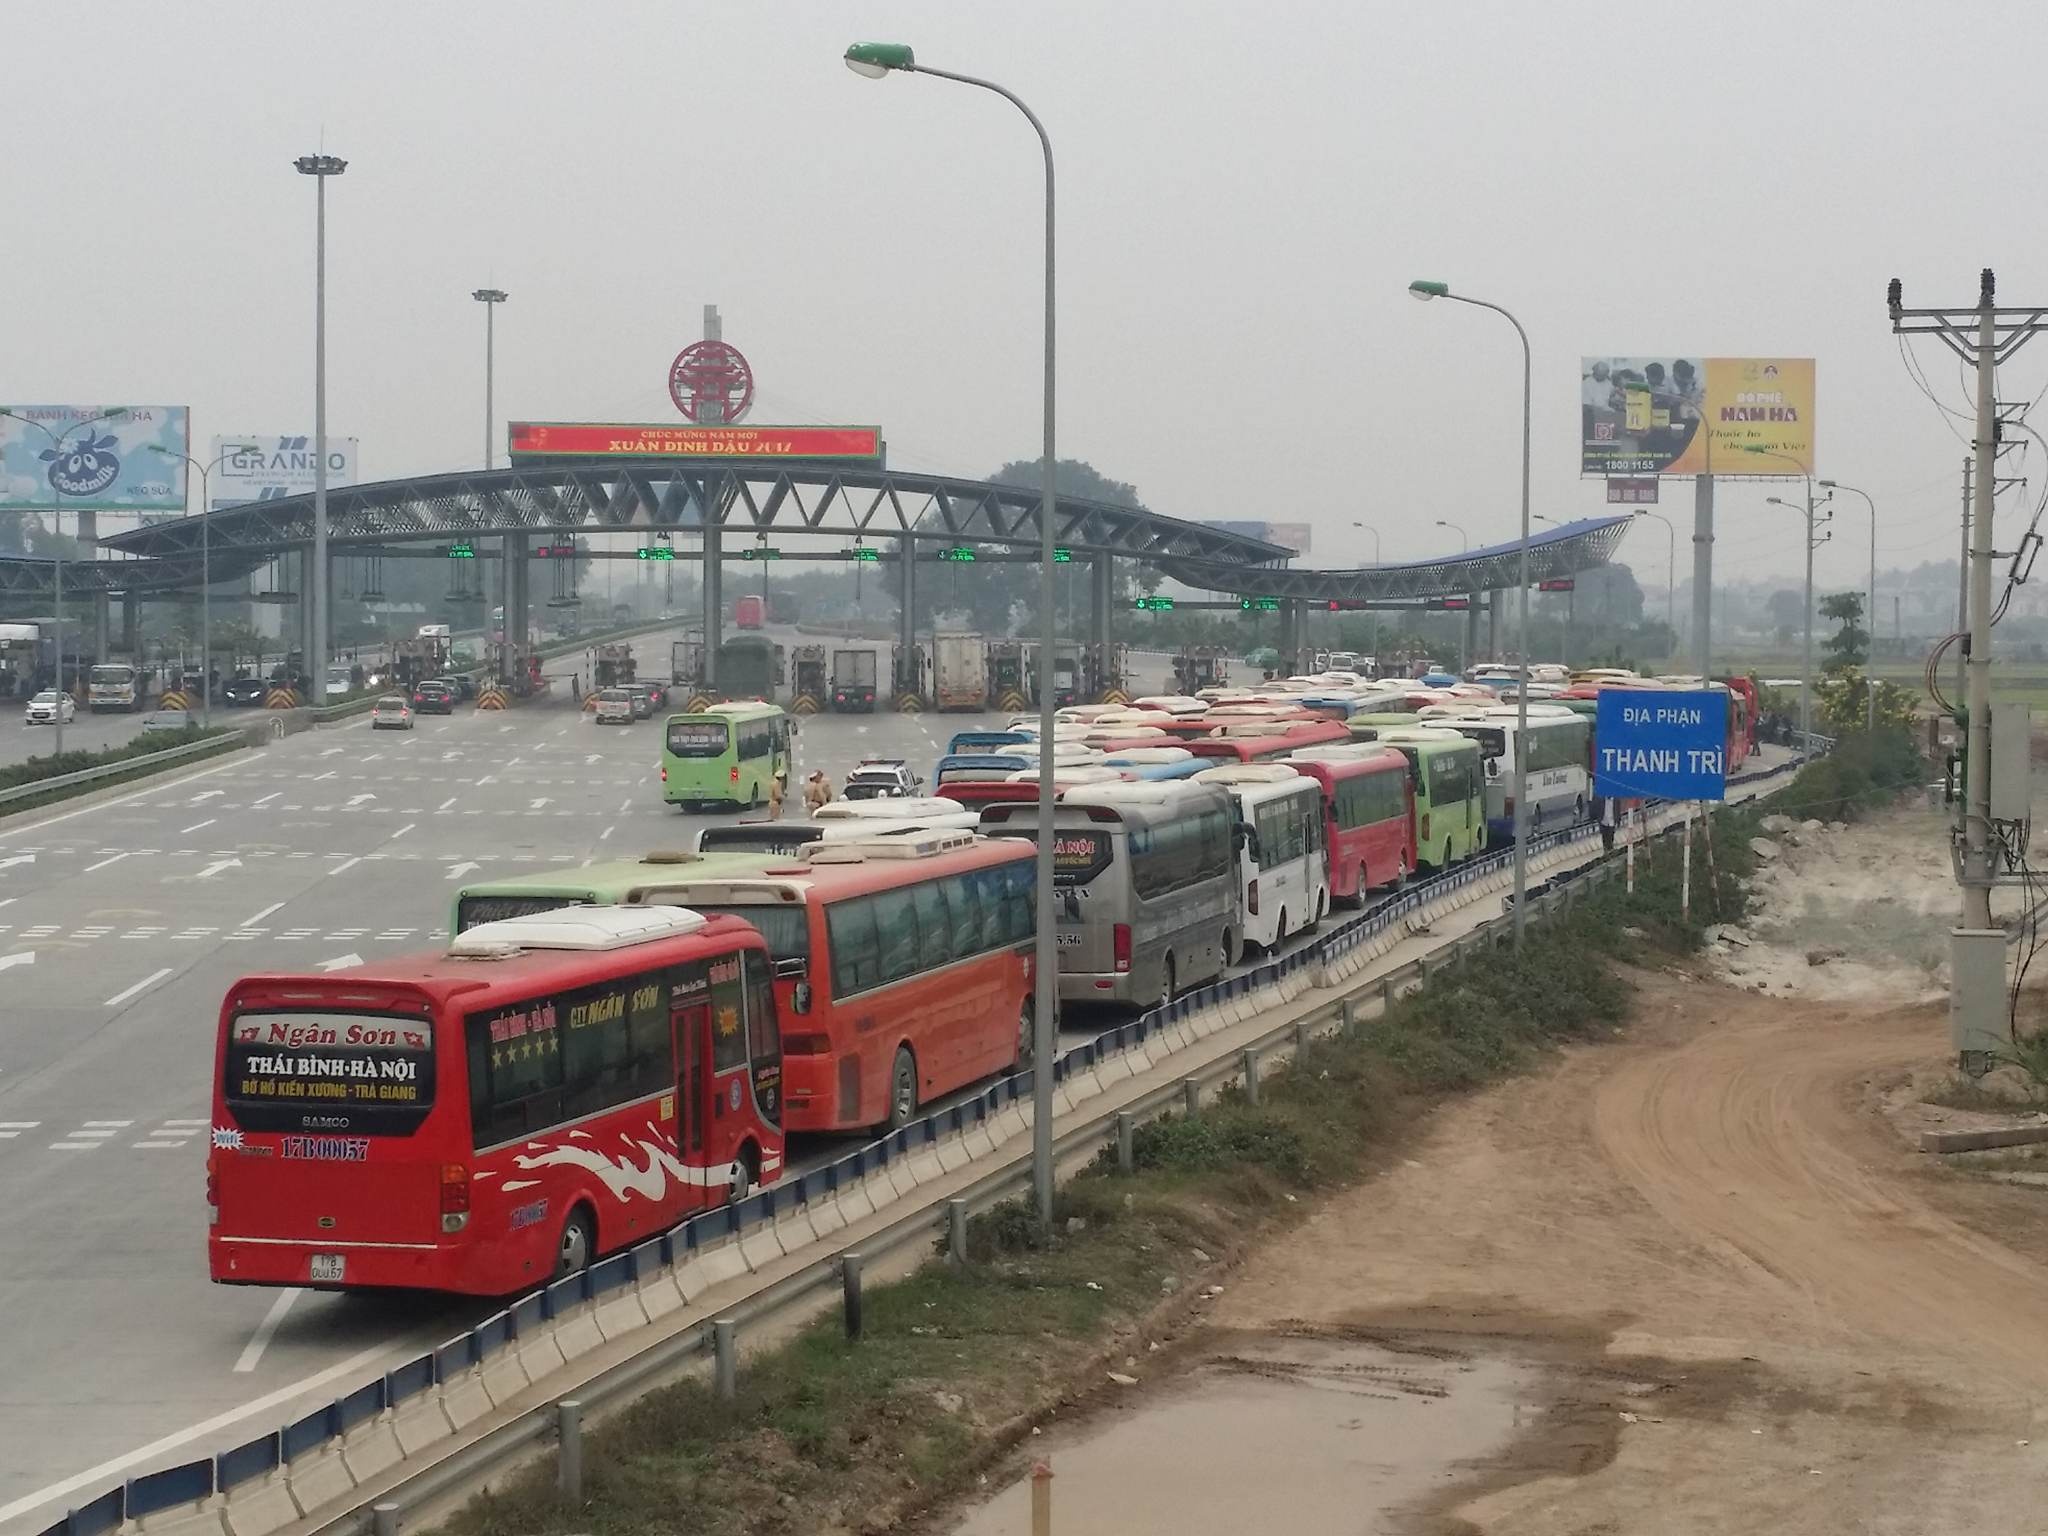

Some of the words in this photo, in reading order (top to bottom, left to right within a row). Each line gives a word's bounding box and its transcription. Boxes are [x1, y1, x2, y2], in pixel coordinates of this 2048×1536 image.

[1720, 407, 1765, 422] NAM
[1623, 708, 1651, 727] ĐỊA
[1656, 707, 1702, 729] PHẬN
[1602, 748, 1680, 774] THANH
[1687, 744, 1723, 775] TRÌ
[267, 1022, 338, 1048] Ngân
[345, 1023, 397, 1045] Sơn
[247, 1053, 294, 1075] THÁI
[380, 1057, 417, 1082] NỘI
[380, 1084, 417, 1100] GIANG
[302, 1116, 350, 1128] SAMCO
